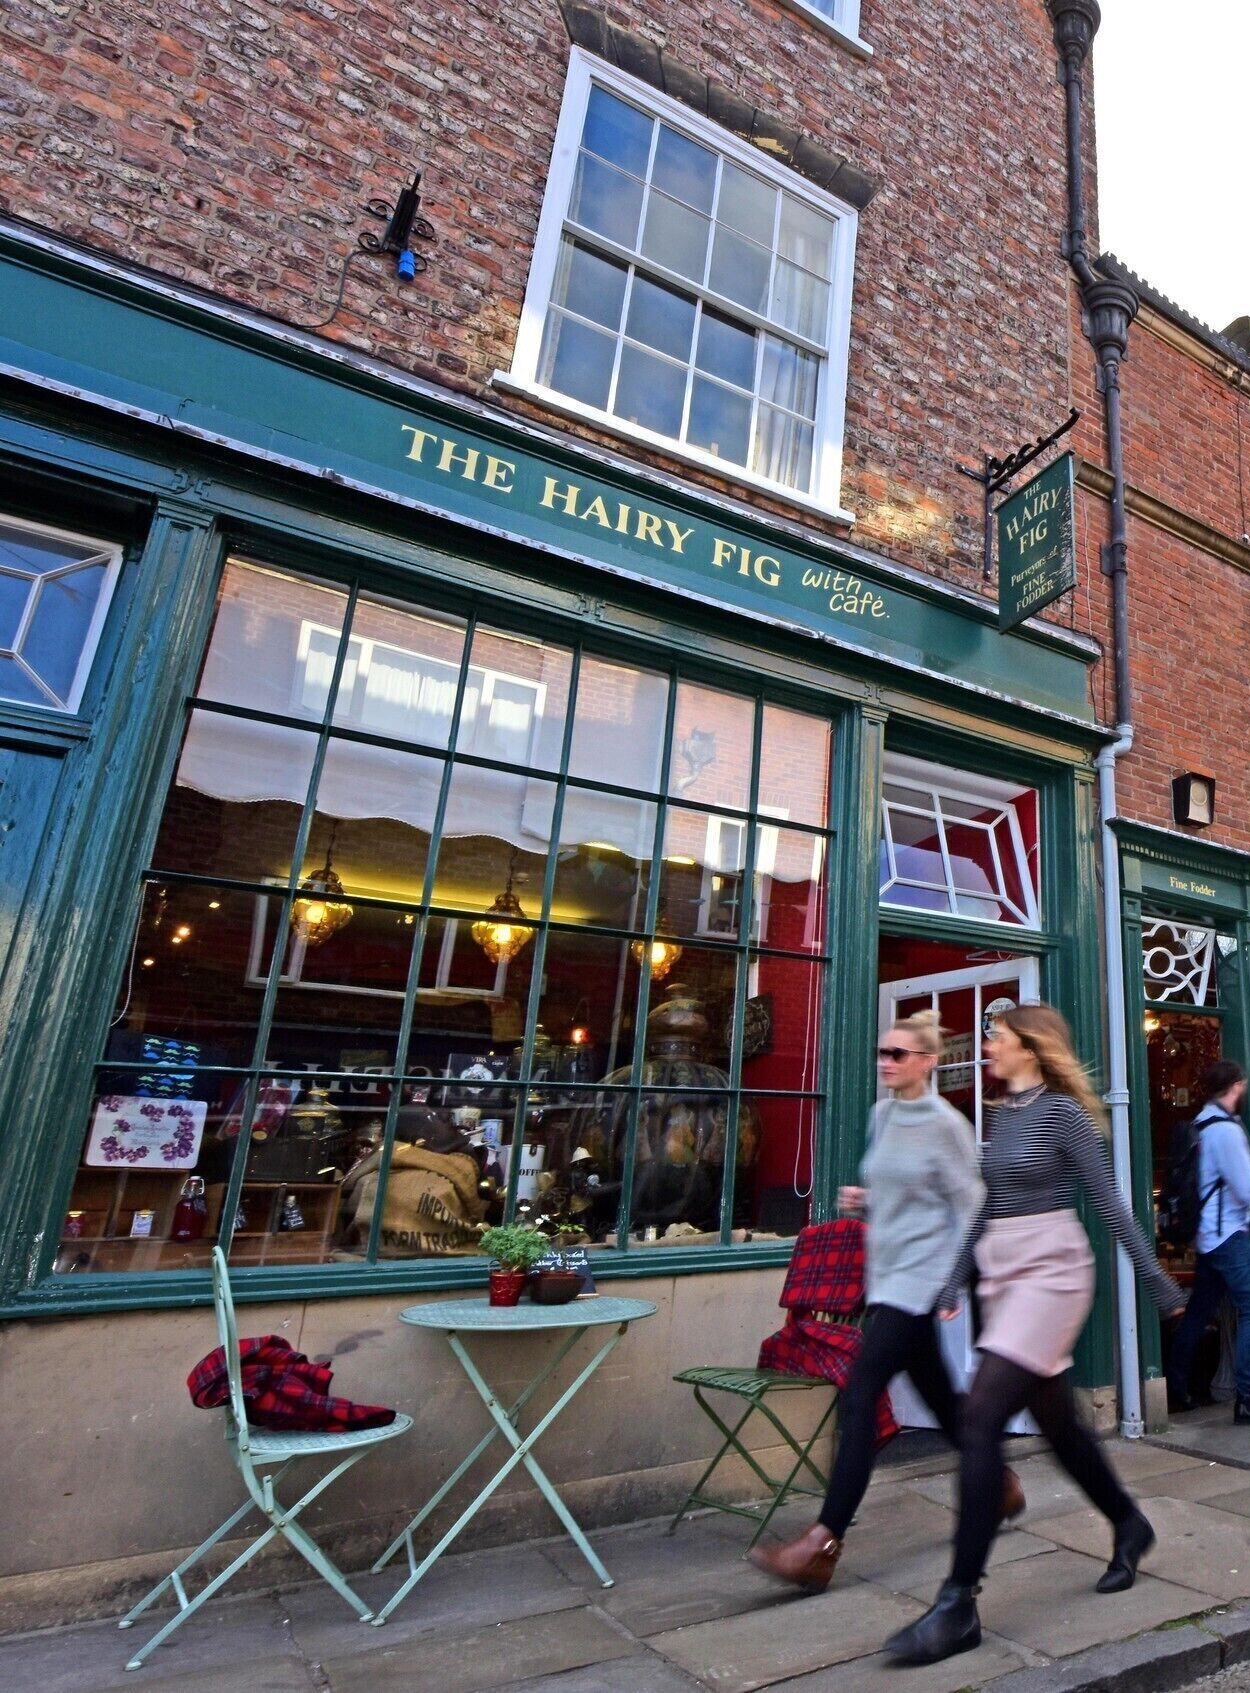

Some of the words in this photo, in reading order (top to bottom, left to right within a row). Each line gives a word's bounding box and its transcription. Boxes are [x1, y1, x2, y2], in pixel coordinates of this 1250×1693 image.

[1024, 480, 1042, 500] THE
[401, 424, 516, 494] THE
[539, 475, 695, 555] HAIRY
[711, 537, 781, 588] FIG
[1006, 486, 1063, 541] HAIRY
[1019, 519, 1048, 555] FIG
[802, 567, 862, 596] with
[1016, 579, 1055, 613] FODDER
[1023, 571, 1046, 596] FINE
[1169, 876, 1188, 889] Fine
[1190, 881, 1216, 897] Fodder
